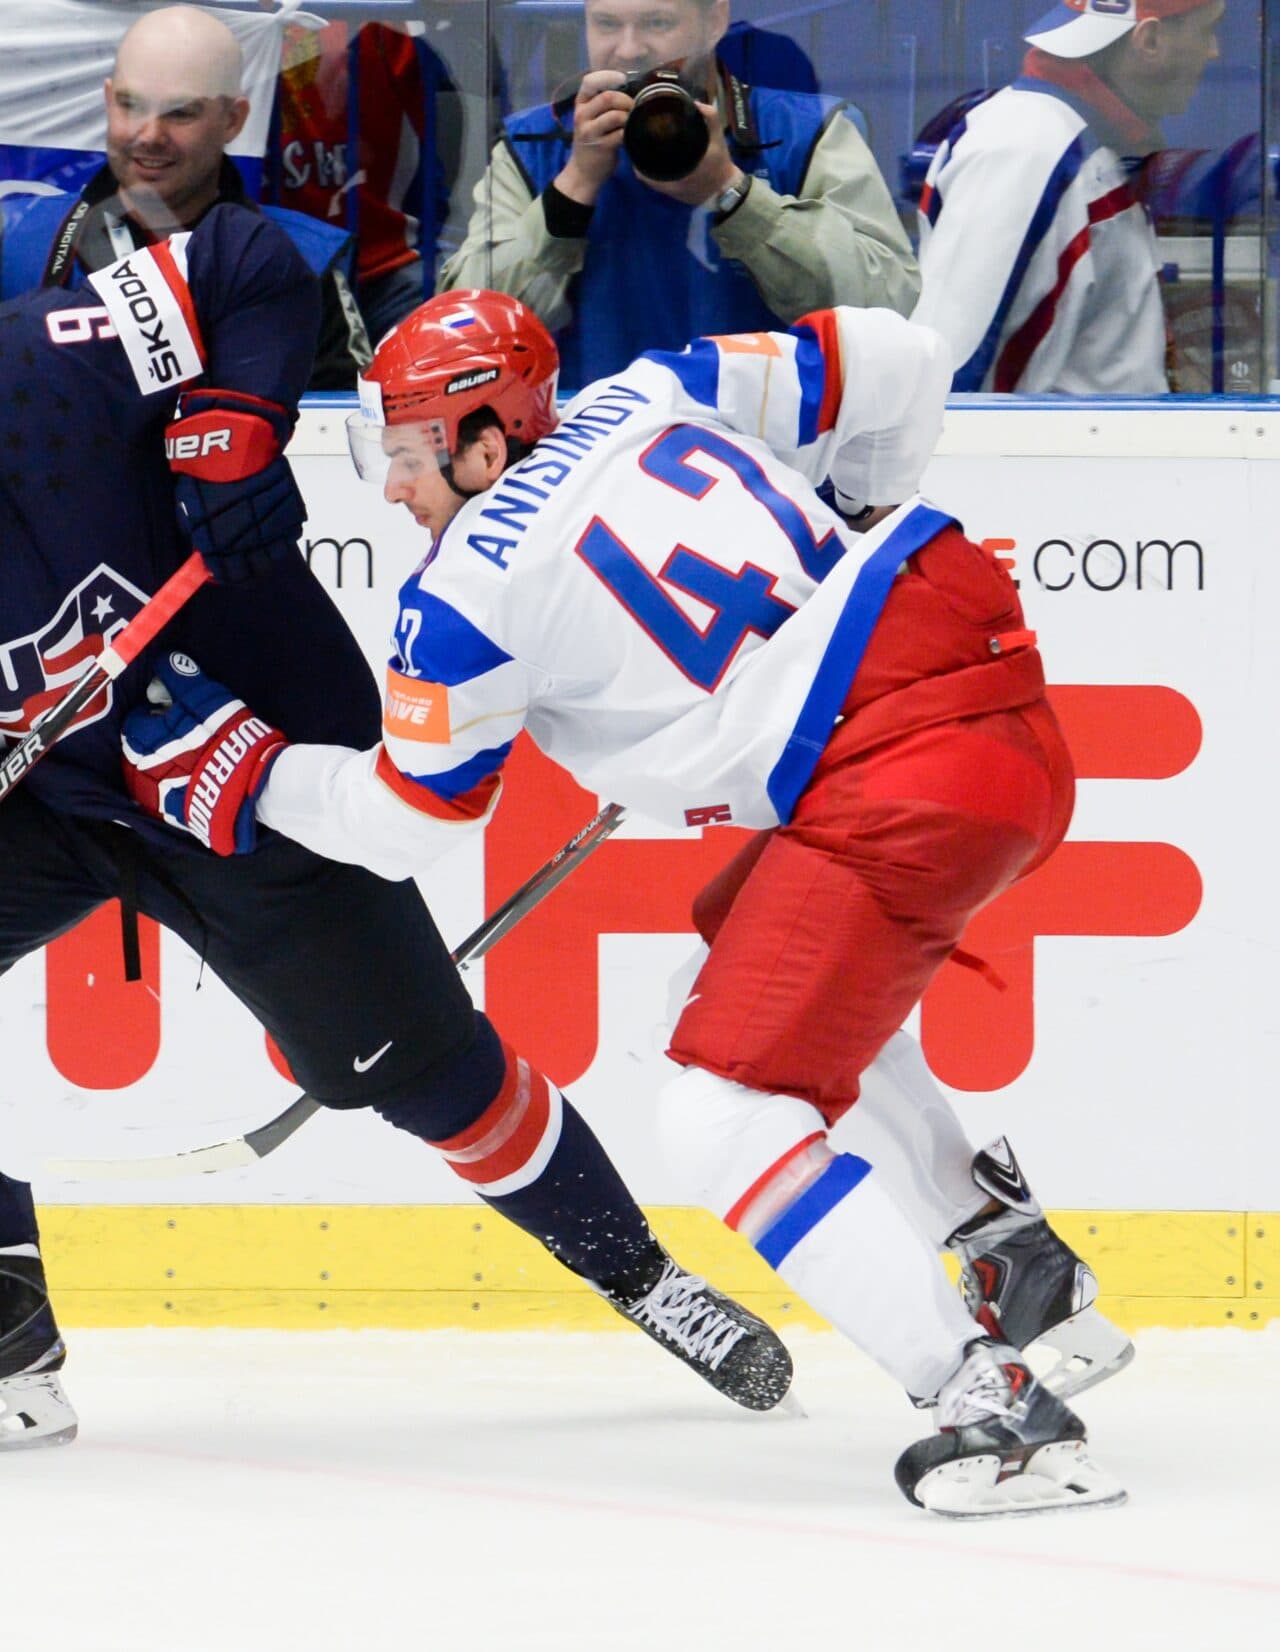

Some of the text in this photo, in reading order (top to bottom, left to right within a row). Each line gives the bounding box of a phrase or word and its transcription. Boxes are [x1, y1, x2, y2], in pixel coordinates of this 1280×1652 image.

[51, 222, 78, 275] DIGITAL
[45, 305, 119, 345] 9
[111, 259, 183, 384] ŠKODA
[447, 369, 498, 395] BAUER
[466, 384, 652, 571] ANISIMOV
[573, 423, 849, 695] 42
